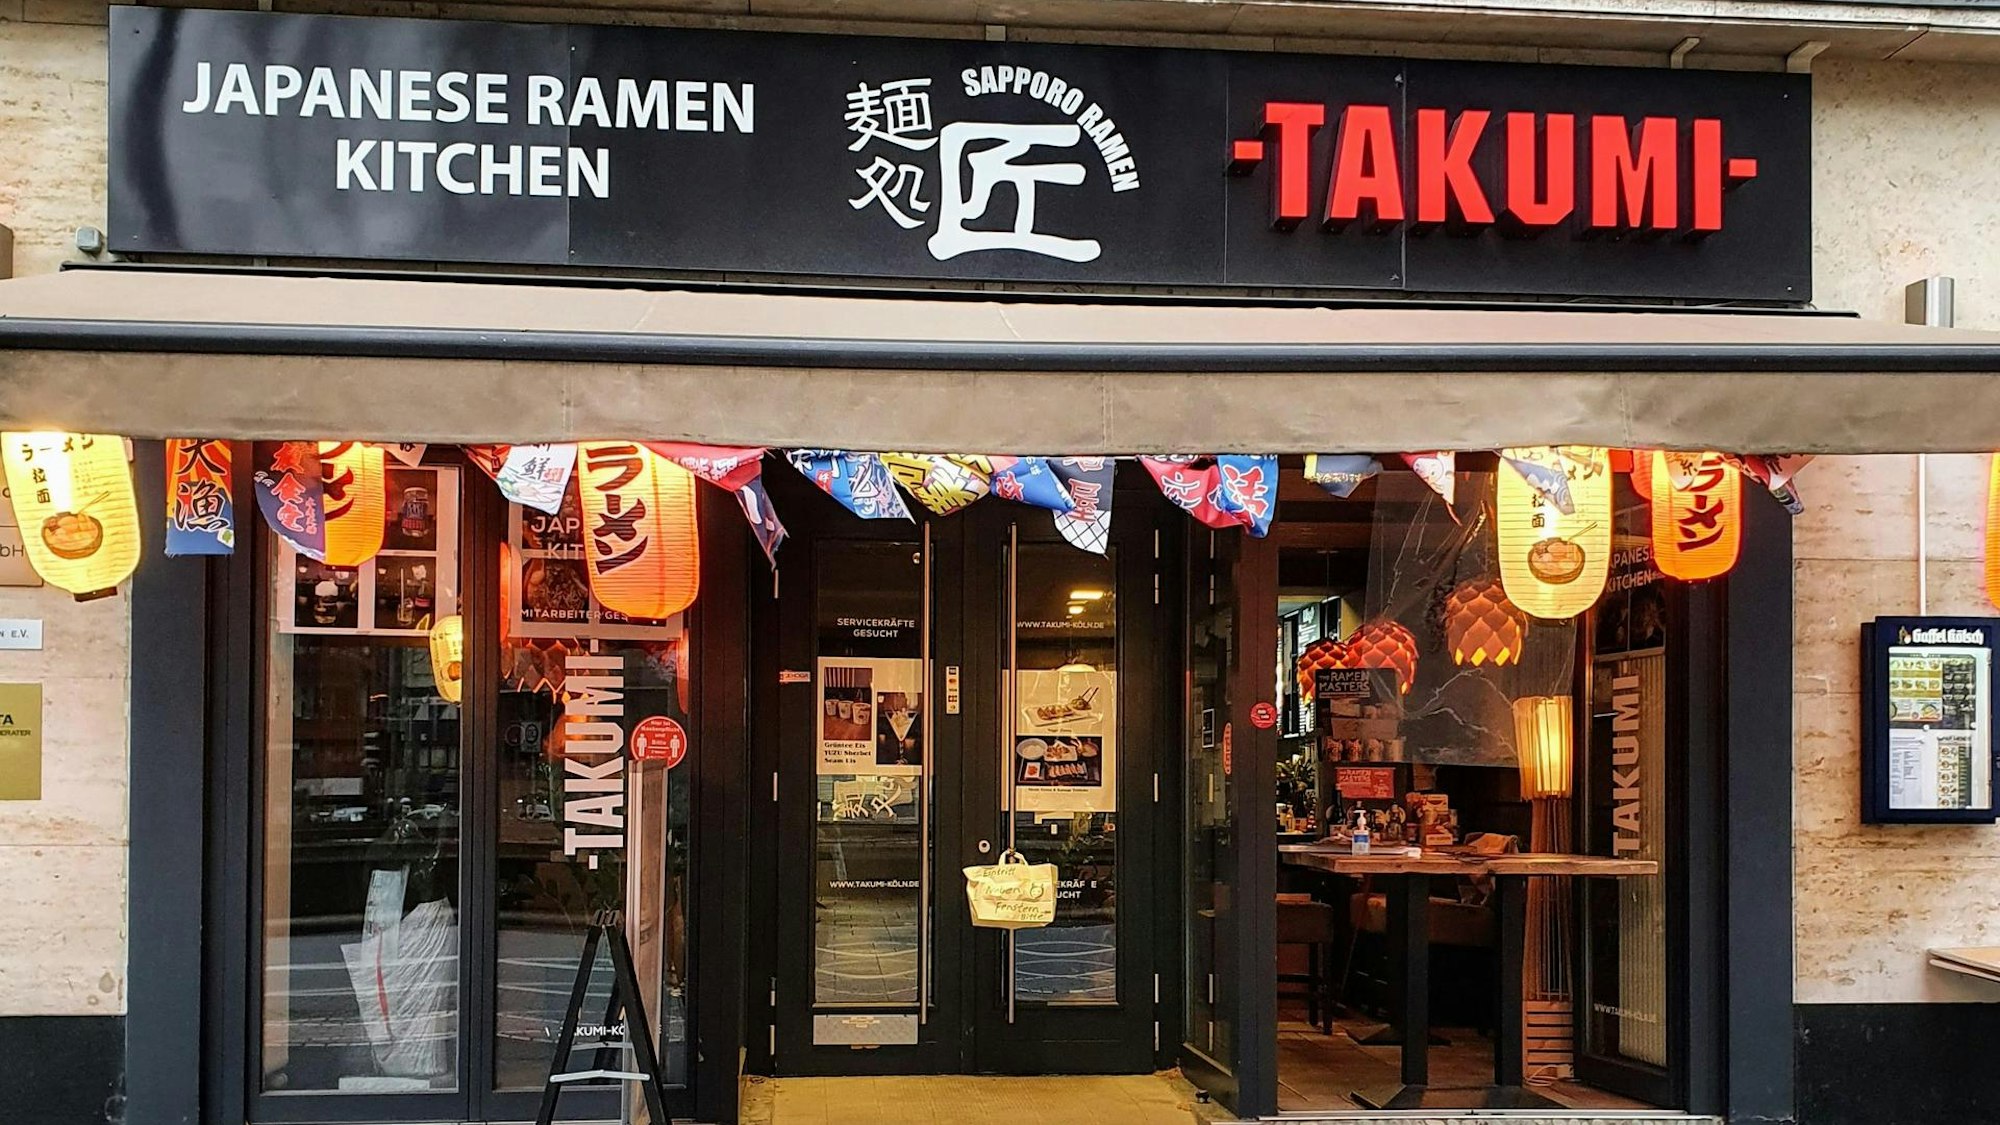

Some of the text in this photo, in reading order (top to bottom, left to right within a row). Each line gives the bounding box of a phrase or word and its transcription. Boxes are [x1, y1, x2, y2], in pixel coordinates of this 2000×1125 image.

[183, 61, 756, 134] JAPANESE RAMEN
[961, 65, 1141, 193] SAPPORO RAMEN
[336, 138, 610, 199] KITCHEN
[1233, 102, 1757, 231] -TAKUMI-
[927, 121, 1101, 262] 匠
[586, 444, 649, 575] ラーメン
[837, 617, 916, 628] SERVICEKRÄFTE
[1016, 621, 1105, 629] WWW.TAKUMI-KÖLN.DE
[853, 628, 899, 638] GESUCHT
[1331, 671, 1370, 682] RAMEN
[1319, 681, 1370, 692] MASTERS
[564, 639, 624, 870] -TAKUMI-
[982, 867, 1016, 878] Eintritt
[829, 879, 920, 889] WWW.TAKUMI-KÖLN.DE
[995, 902, 1039, 914] Fenstern
